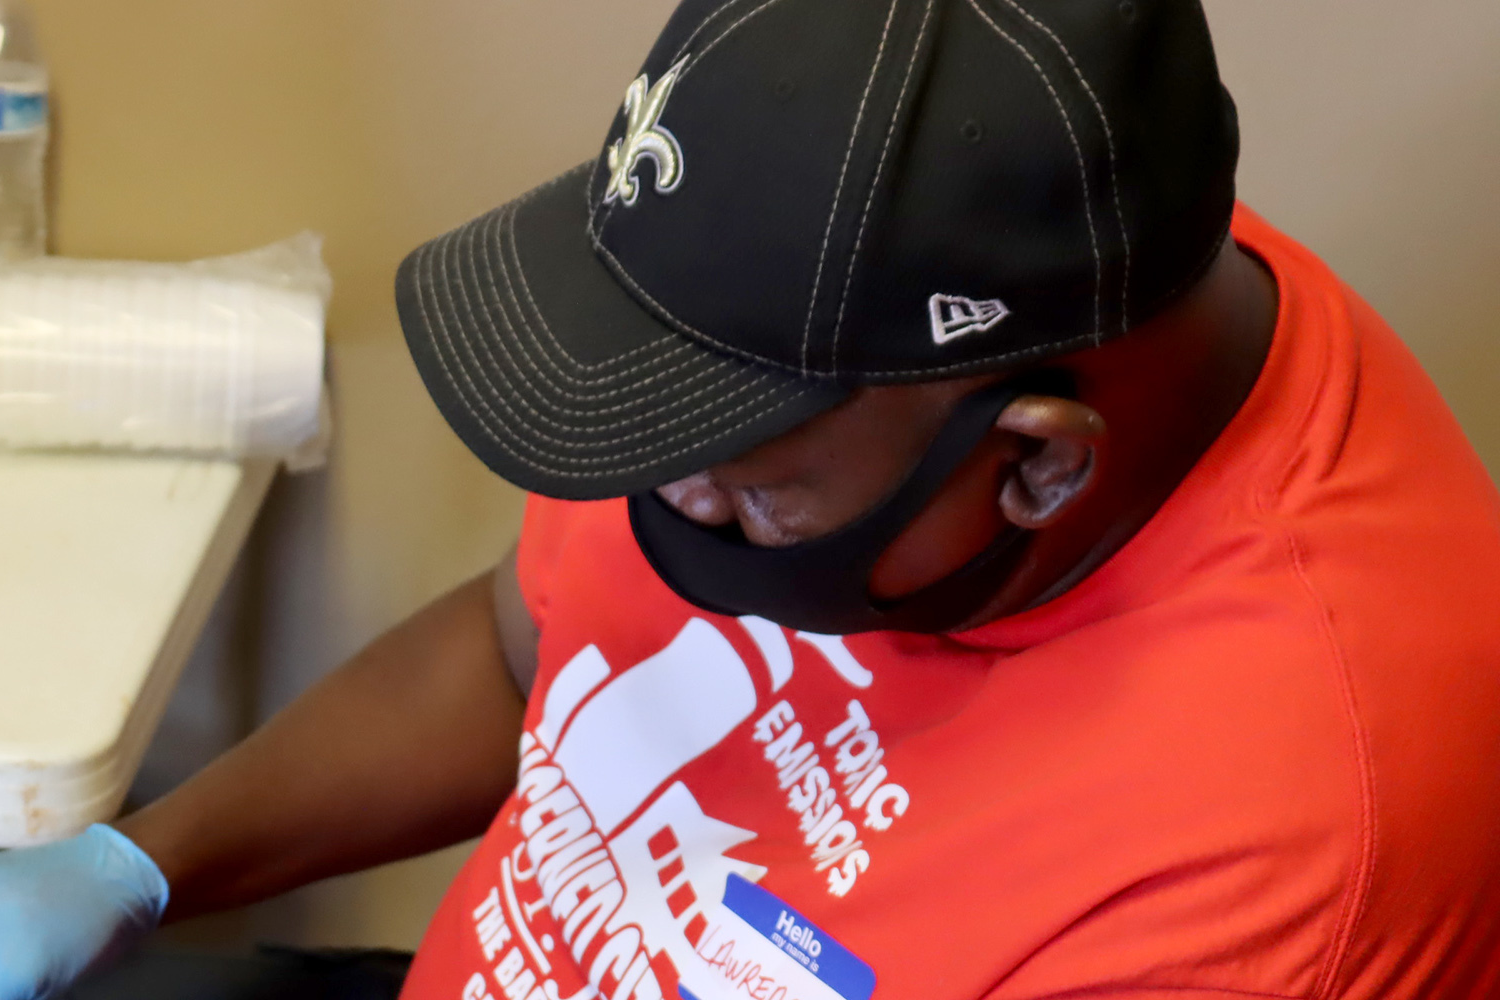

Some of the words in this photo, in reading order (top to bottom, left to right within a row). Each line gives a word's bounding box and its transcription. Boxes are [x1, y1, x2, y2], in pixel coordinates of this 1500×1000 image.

[824, 699, 910, 831] TOXIC
[472, 886, 513, 963] THE
[770, 932, 785, 949] my
[785, 943, 809, 966] name
[810, 958, 820, 973] is
[776, 910, 821, 957] Hello
